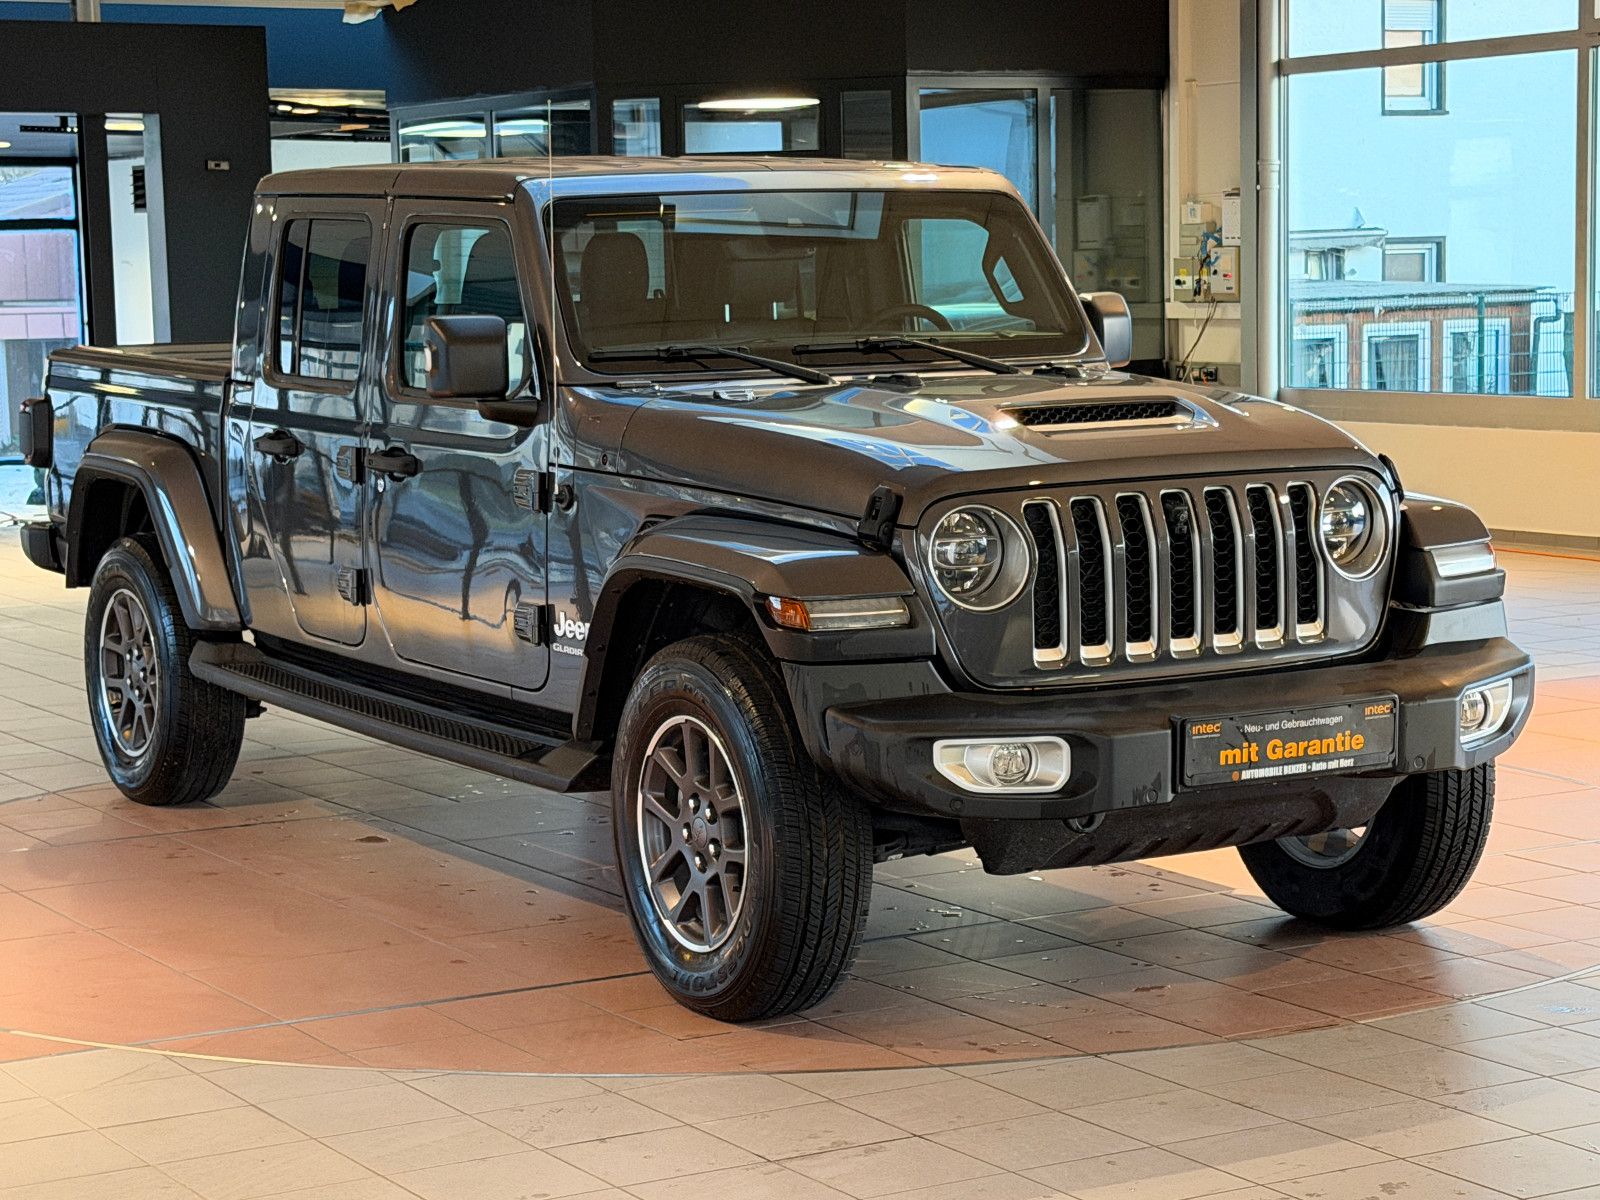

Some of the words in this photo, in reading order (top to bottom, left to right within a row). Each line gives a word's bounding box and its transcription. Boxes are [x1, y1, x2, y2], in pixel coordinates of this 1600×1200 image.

[1365, 704, 1392, 715] intec
[1192, 722, 1221, 735] intec
[1244, 724, 1263, 733] Neu-
[1265, 721, 1280, 731] und
[1281, 715, 1343, 729] Gebrauchtwagen
[1219, 741, 1259, 766] mit
[1266, 730, 1365, 760] Garantie
[1241, 766, 1283, 780] AUTOMOBILE
